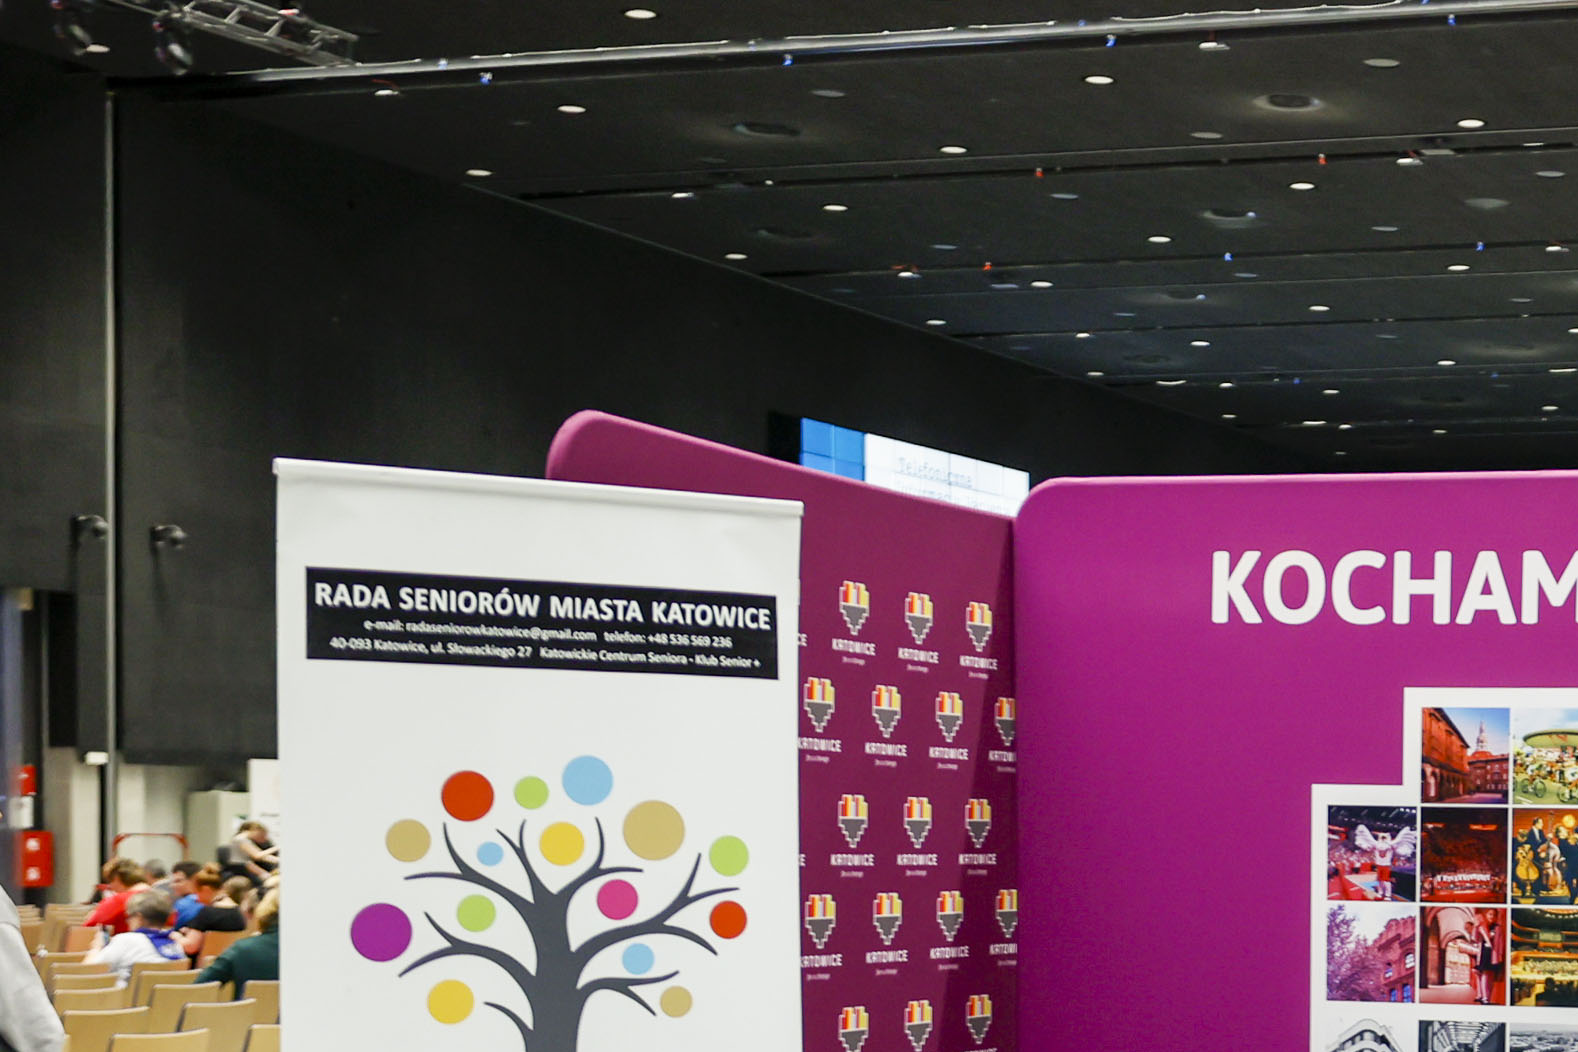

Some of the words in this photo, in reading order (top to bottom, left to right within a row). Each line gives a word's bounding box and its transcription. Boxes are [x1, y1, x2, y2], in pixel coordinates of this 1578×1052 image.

[315, 581, 391, 610] RADA
[399, 586, 539, 618] SENIORÓW
[549, 596, 643, 623] MIASTA
[652, 602, 771, 630] KATOWICE
[364, 619, 403, 631] e-mail:
[604, 630, 646, 643] telefon:
[648, 633, 668, 645] +48
[670, 634, 689, 646] 536
[692, 635, 710, 647] 569
[712, 636, 732, 648] 236
[832, 638, 876, 656] KATOWICE
[517, 646, 532, 657] 27
[539, 646, 597, 661] Katowickie
[600, 649, 646, 662] Centrum
[648, 651, 688, 665] Seniora
[695, 655, 718, 667] Klub
[720, 656, 752, 667] Senior
[898, 647, 939, 664] KATOWICE
[960, 655, 997, 671] KATOWICE
[865, 742, 907, 758] KATOWICE
[929, 746, 969, 760] KATOWICE
[831, 853, 875, 866] KATOWICE
[897, 853, 938, 866] KATOWICE
[958, 853, 997, 865] KATOWICE
[866, 950, 908, 964] KATOWICE
[930, 946, 969, 960] KATOWICE
